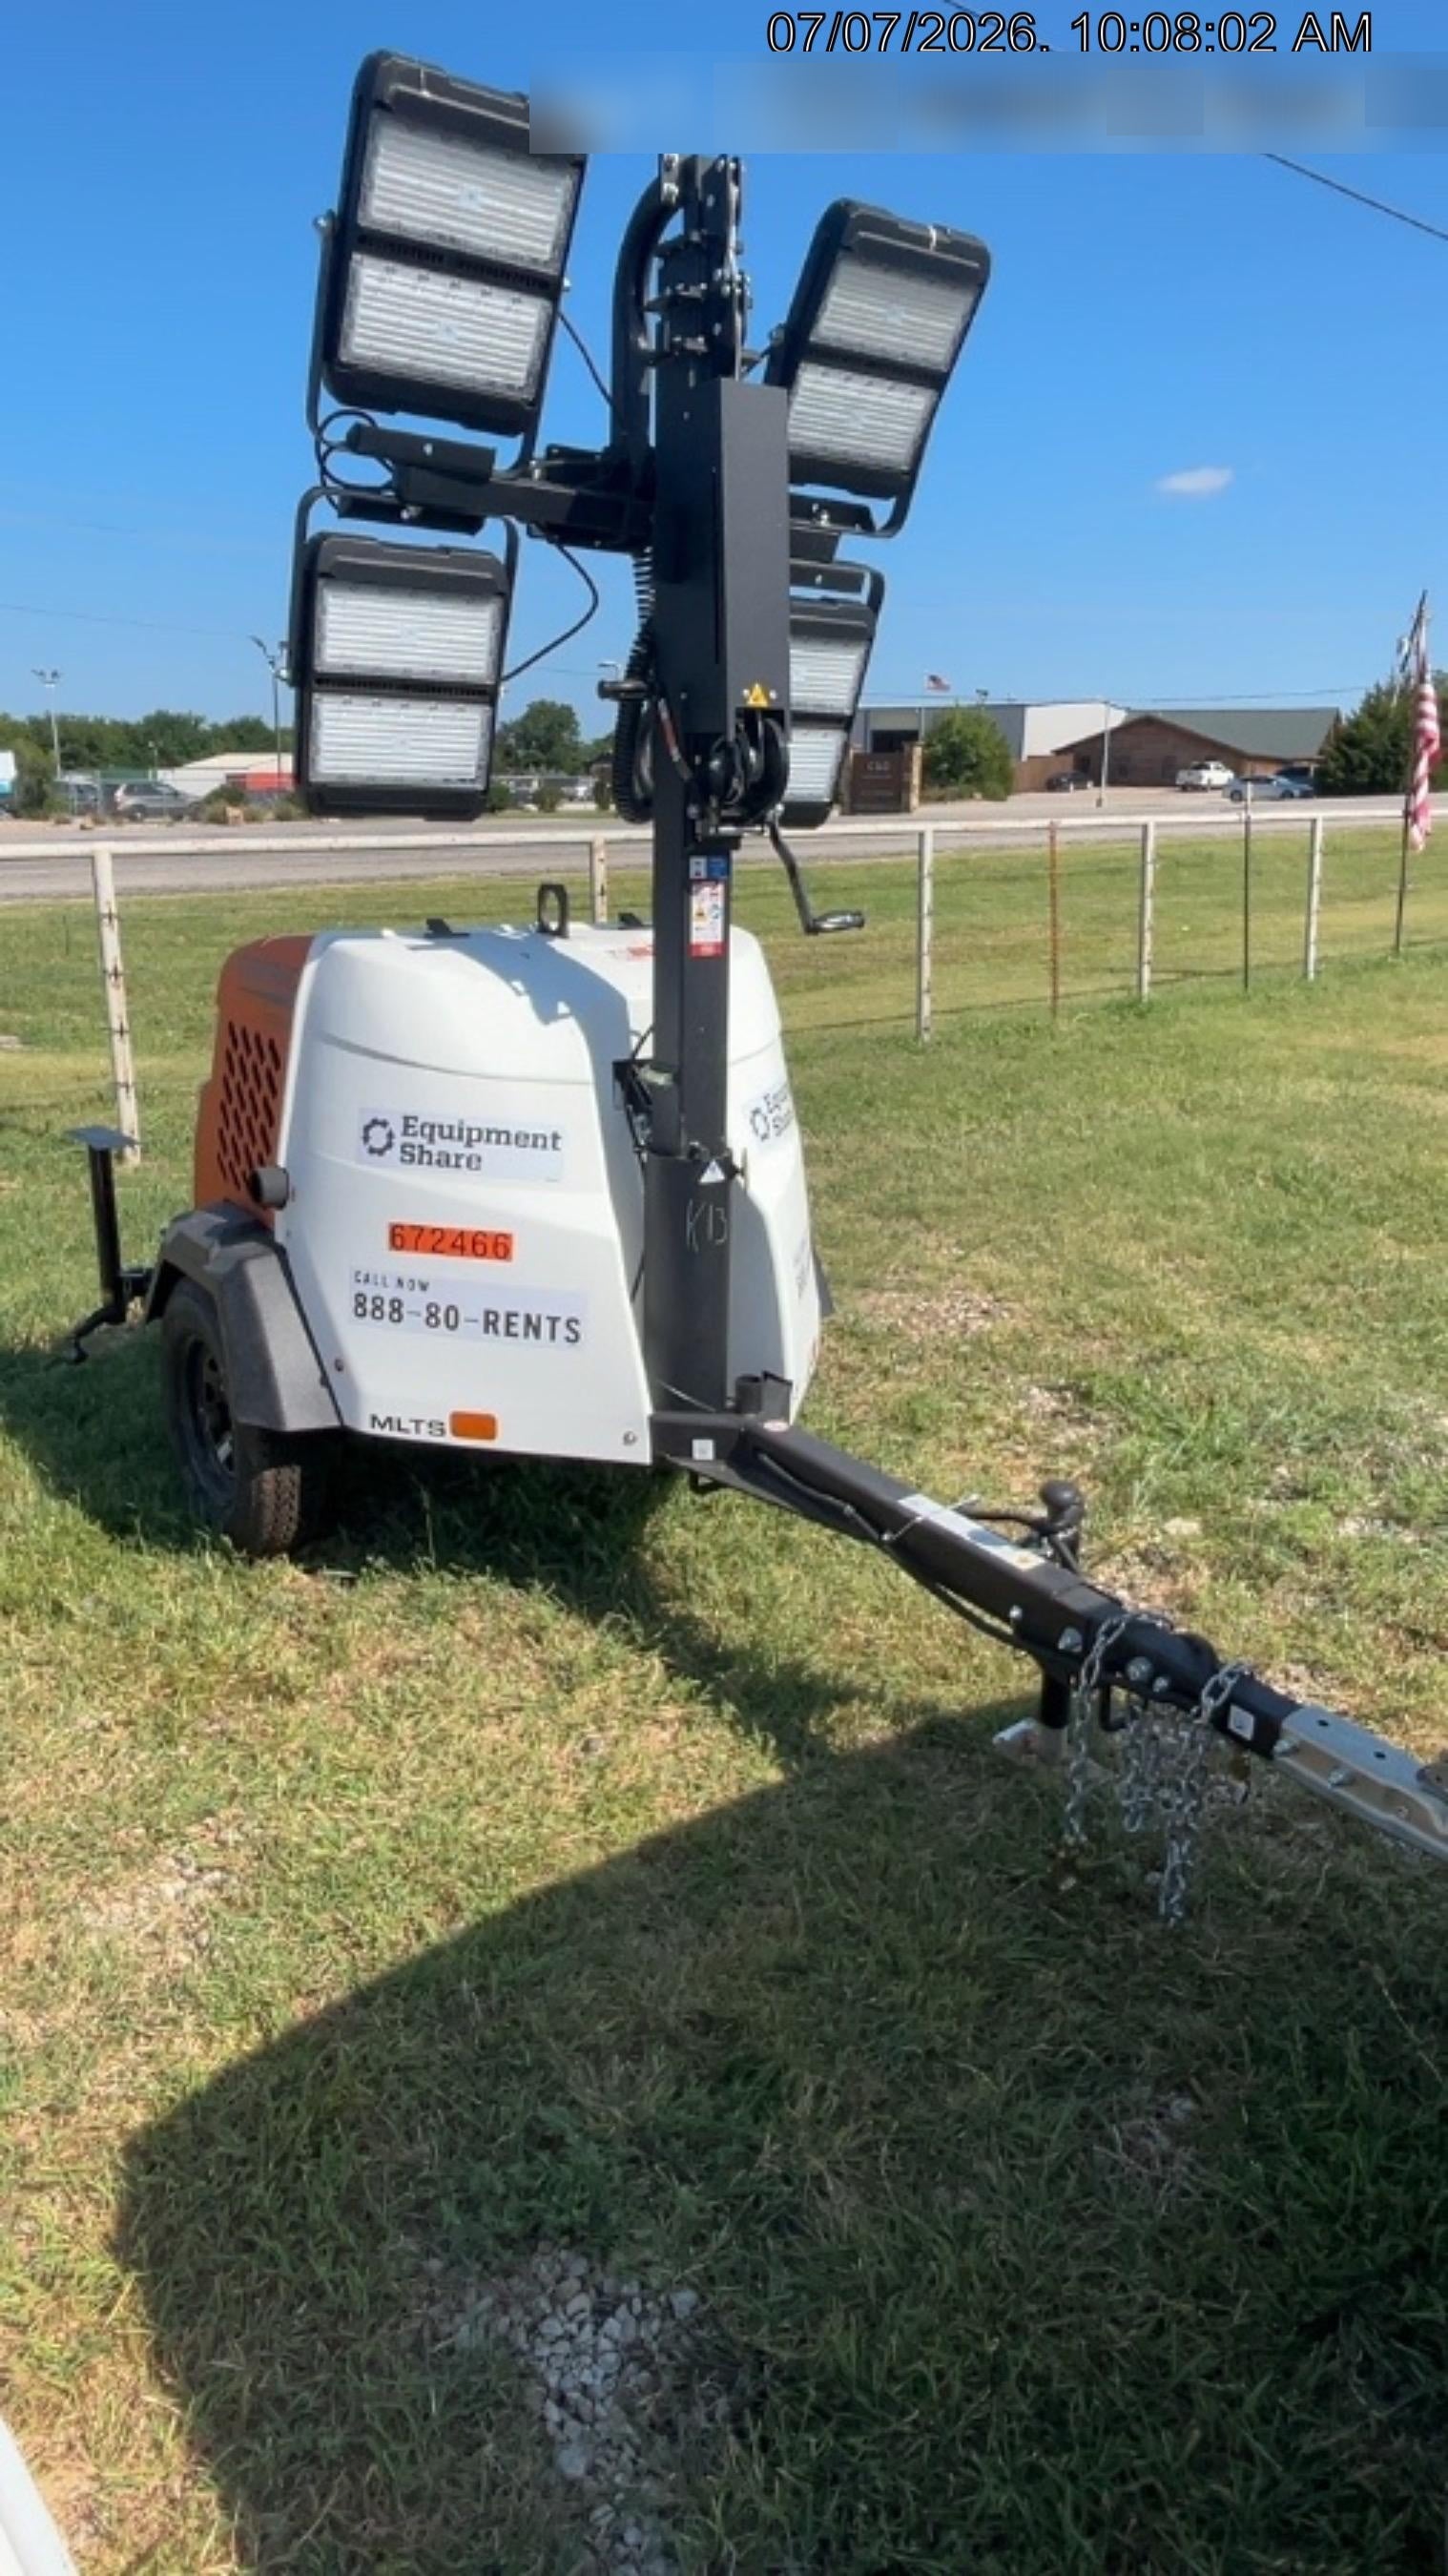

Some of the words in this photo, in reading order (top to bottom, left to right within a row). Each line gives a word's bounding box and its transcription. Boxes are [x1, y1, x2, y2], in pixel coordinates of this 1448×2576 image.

[401, 1114, 562, 1151] Equipment
[399, 1142, 483, 1172] Share
[390, 1223, 512, 1260] 672466
[354, 1270, 390, 1288] CALL
[397, 1278, 430, 1293] NOW
[353, 1292, 581, 1343] 888-80-RENTS
[369, 1413, 446, 1437] MLTS
